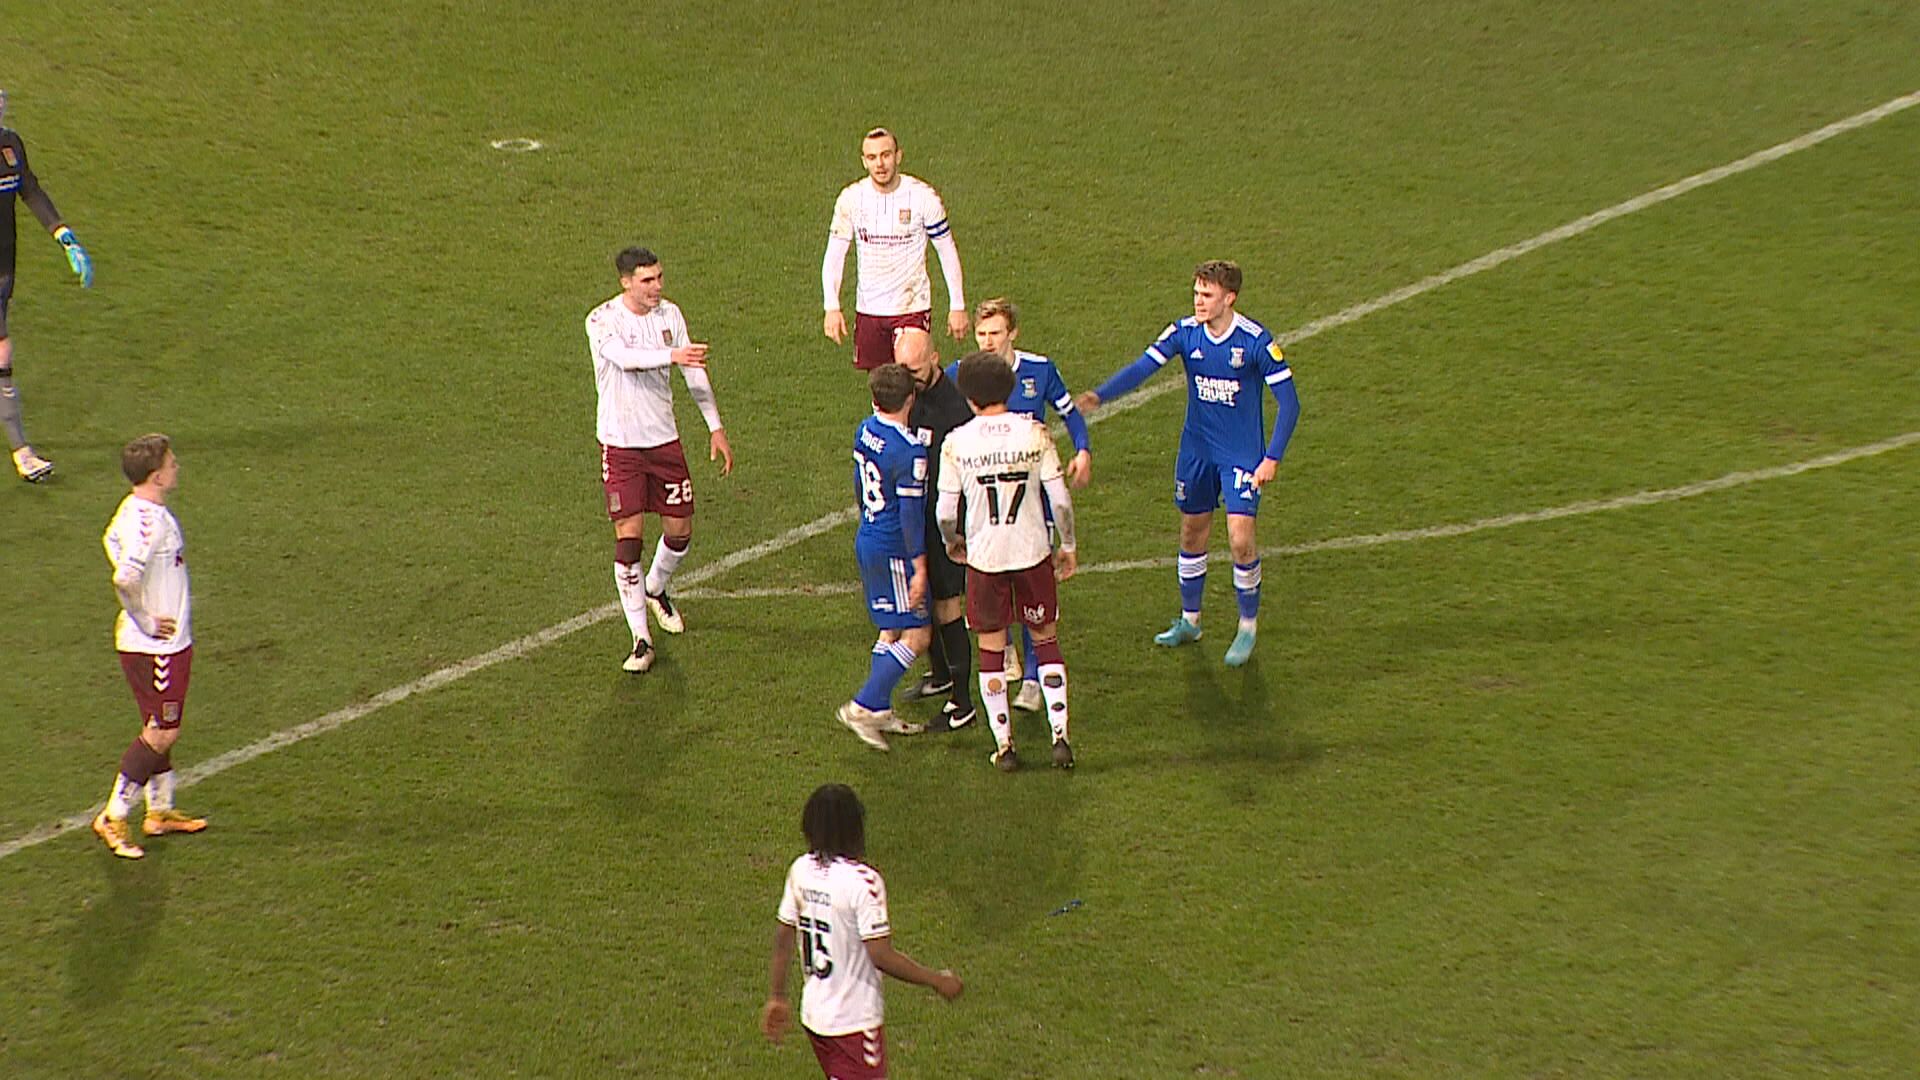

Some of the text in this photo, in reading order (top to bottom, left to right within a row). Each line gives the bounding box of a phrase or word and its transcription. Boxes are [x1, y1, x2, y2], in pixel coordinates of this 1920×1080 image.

[1195, 375, 1240, 392] CARERS
[1197, 385, 1234, 404] TRUST
[664, 479, 693, 505] 28
[853, 449, 886, 512] 18
[977, 471, 1029, 525] 17
[799, 916, 833, 980] 15
